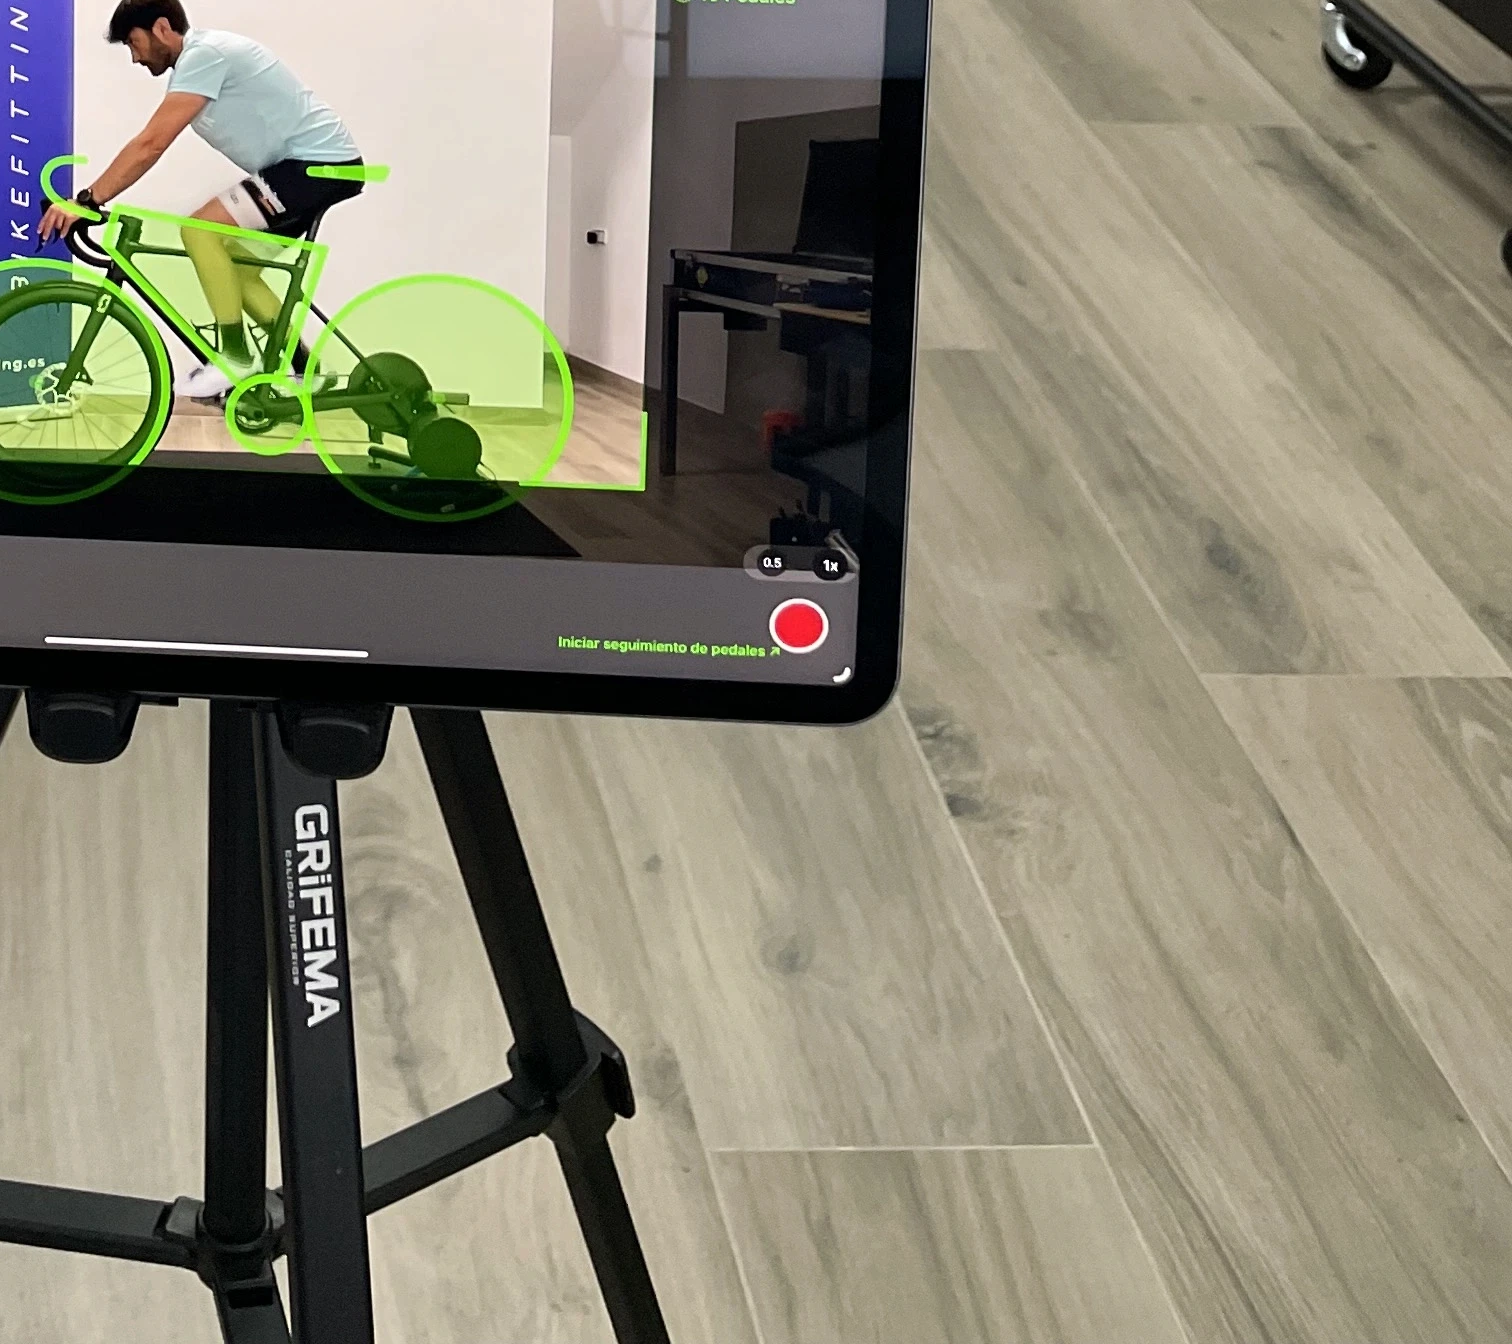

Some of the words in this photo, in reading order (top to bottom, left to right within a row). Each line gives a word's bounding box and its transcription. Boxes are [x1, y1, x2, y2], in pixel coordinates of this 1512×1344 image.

[762, 556, 782, 569] 0.5
[822, 559, 839, 572] 1x
[558, 635, 600, 649] Iniciar
[603, 638, 688, 653] seguimiento
[690, 641, 708, 655] de
[711, 644, 766, 658] pedales
[284, 849, 296, 910] CALIDAD
[288, 914, 300, 986] SUPERIOR
